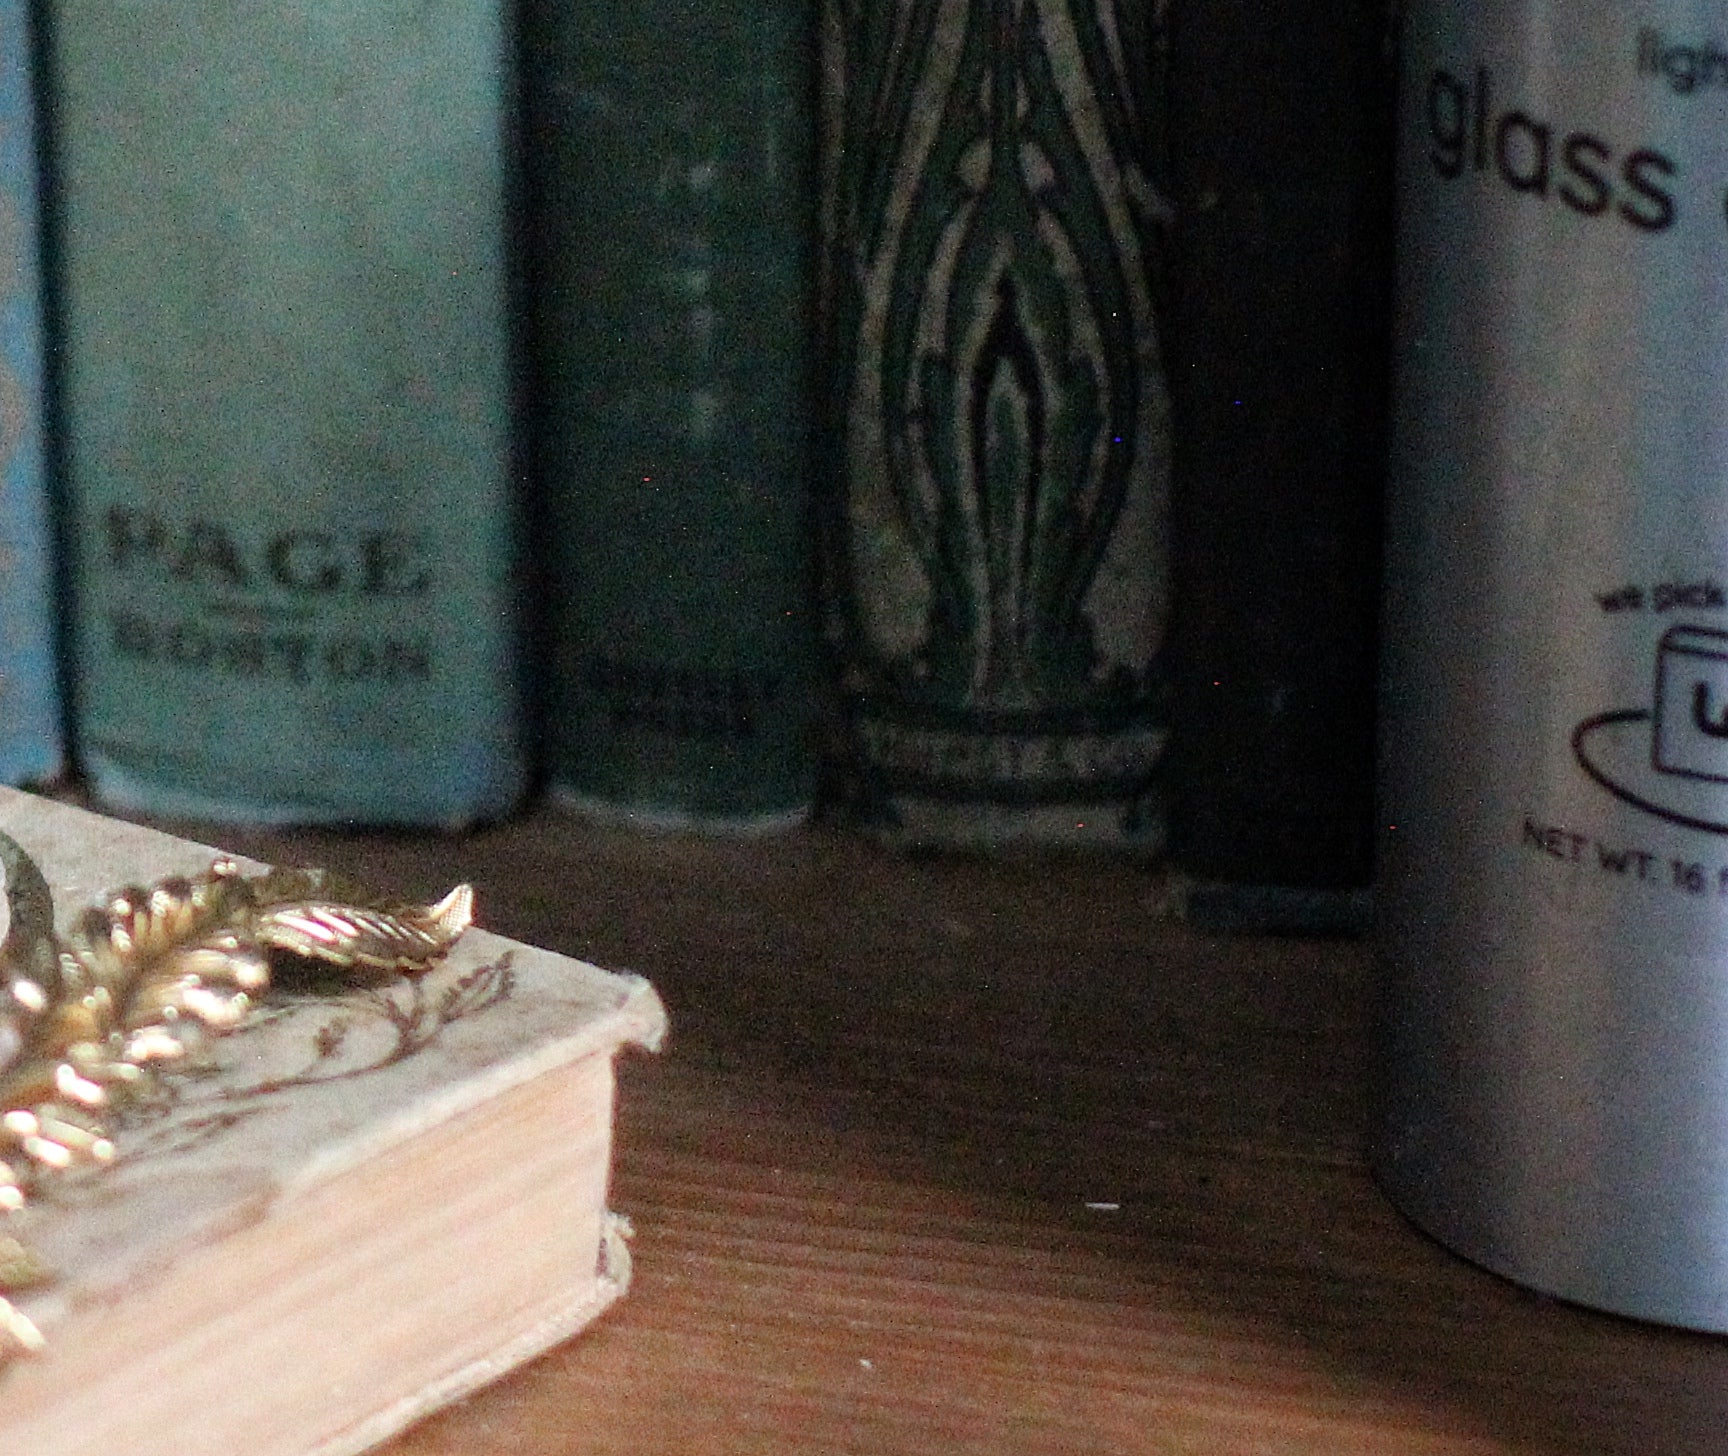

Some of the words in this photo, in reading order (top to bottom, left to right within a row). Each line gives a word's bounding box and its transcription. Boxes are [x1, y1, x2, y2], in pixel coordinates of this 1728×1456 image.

[1428, 63, 1679, 233] glass
[105, 503, 433, 596] PAGE
[1522, 817, 1587, 862] NET
